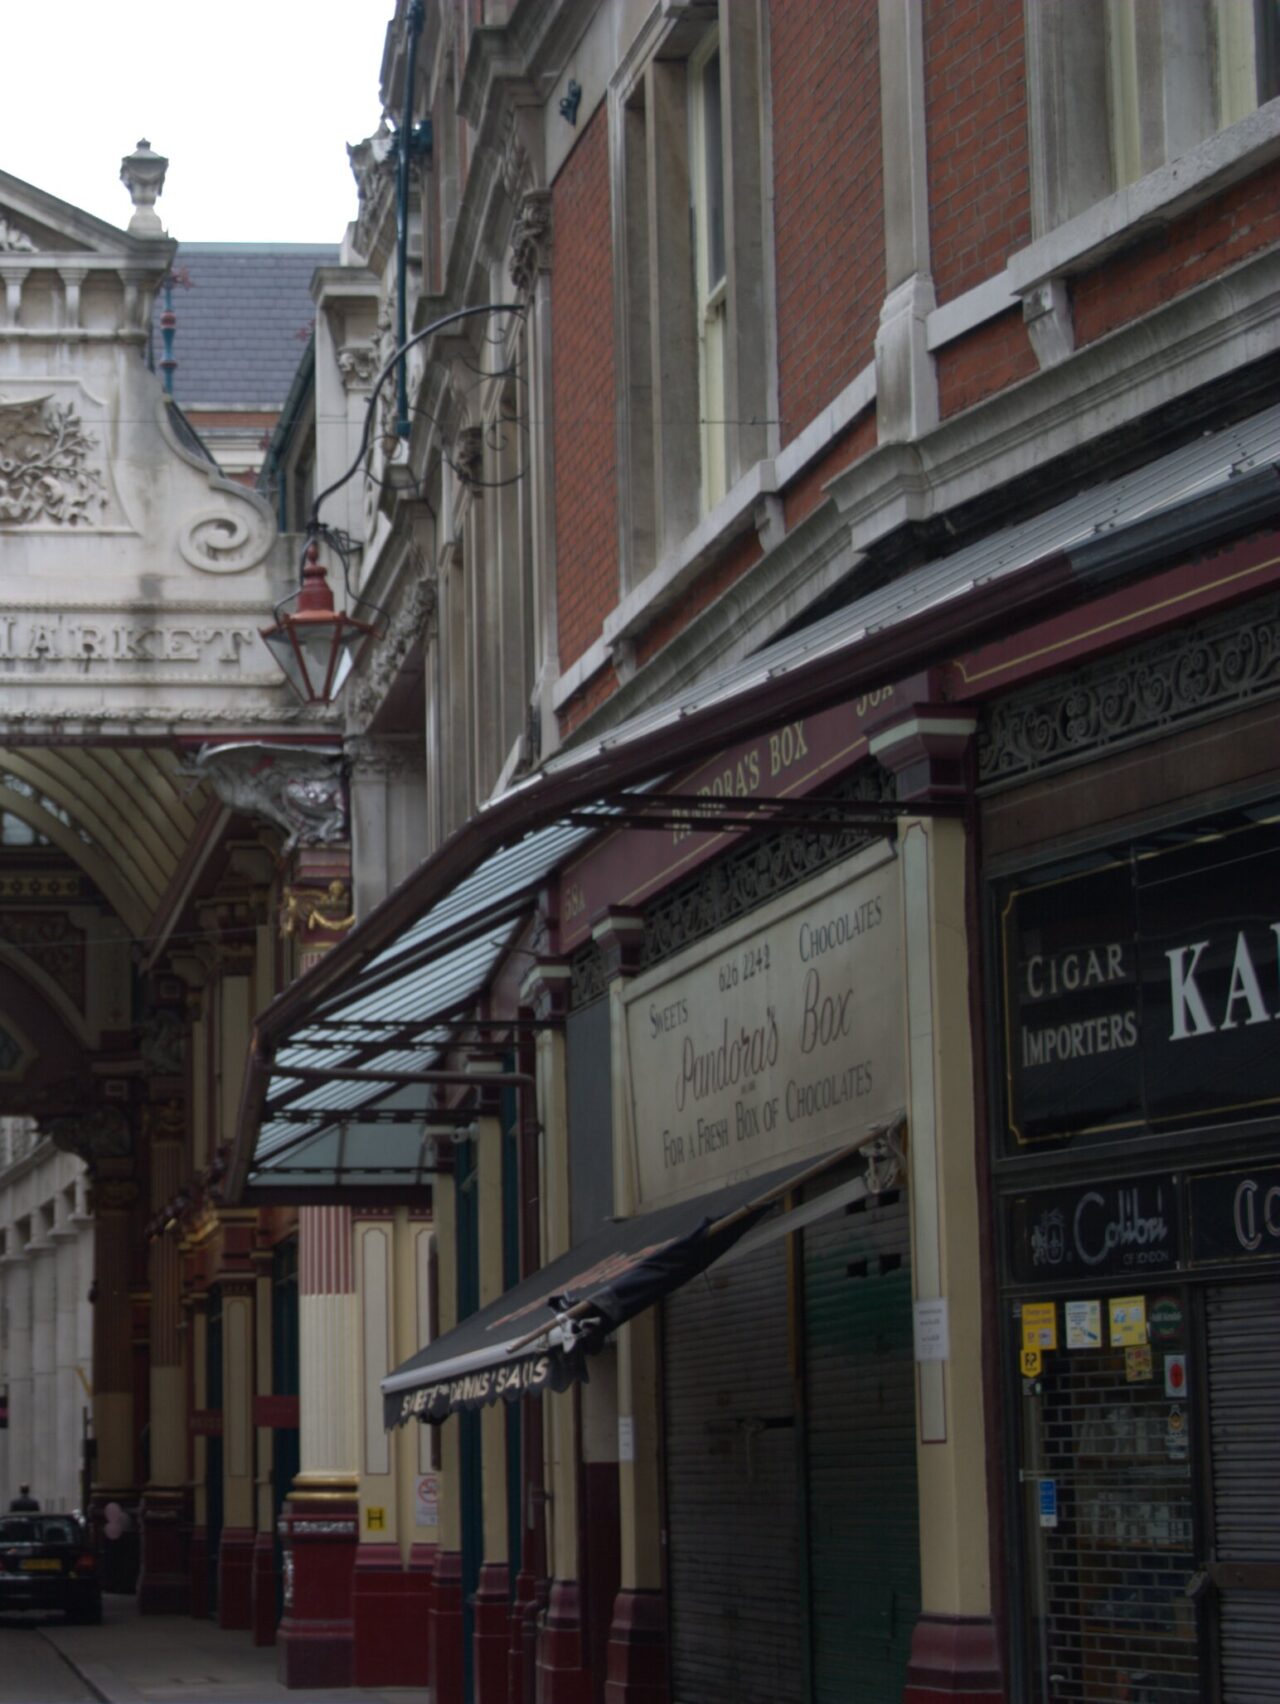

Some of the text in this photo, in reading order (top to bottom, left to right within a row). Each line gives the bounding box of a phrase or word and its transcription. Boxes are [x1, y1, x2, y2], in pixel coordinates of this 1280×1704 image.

[769, 719, 809, 778] BOX
[799, 895, 882, 963] CHOCOLATES
[1026, 942, 1127, 998] CIGAR
[1163, 922, 1280, 1043] KA
[649, 998, 689, 1039] SWEETS
[675, 967, 854, 1112] Pandora's Box
[1022, 1009, 1139, 1069] IMPORTERS
[662, 1129, 685, 1169] FOR
[697, 1117, 729, 1157] FRESH
[735, 1100, 760, 1141] BOX
[763, 1097, 780, 1132] OF
[785, 1059, 873, 1123] CHOCOLATES
[367, 1508, 383, 1529] H
